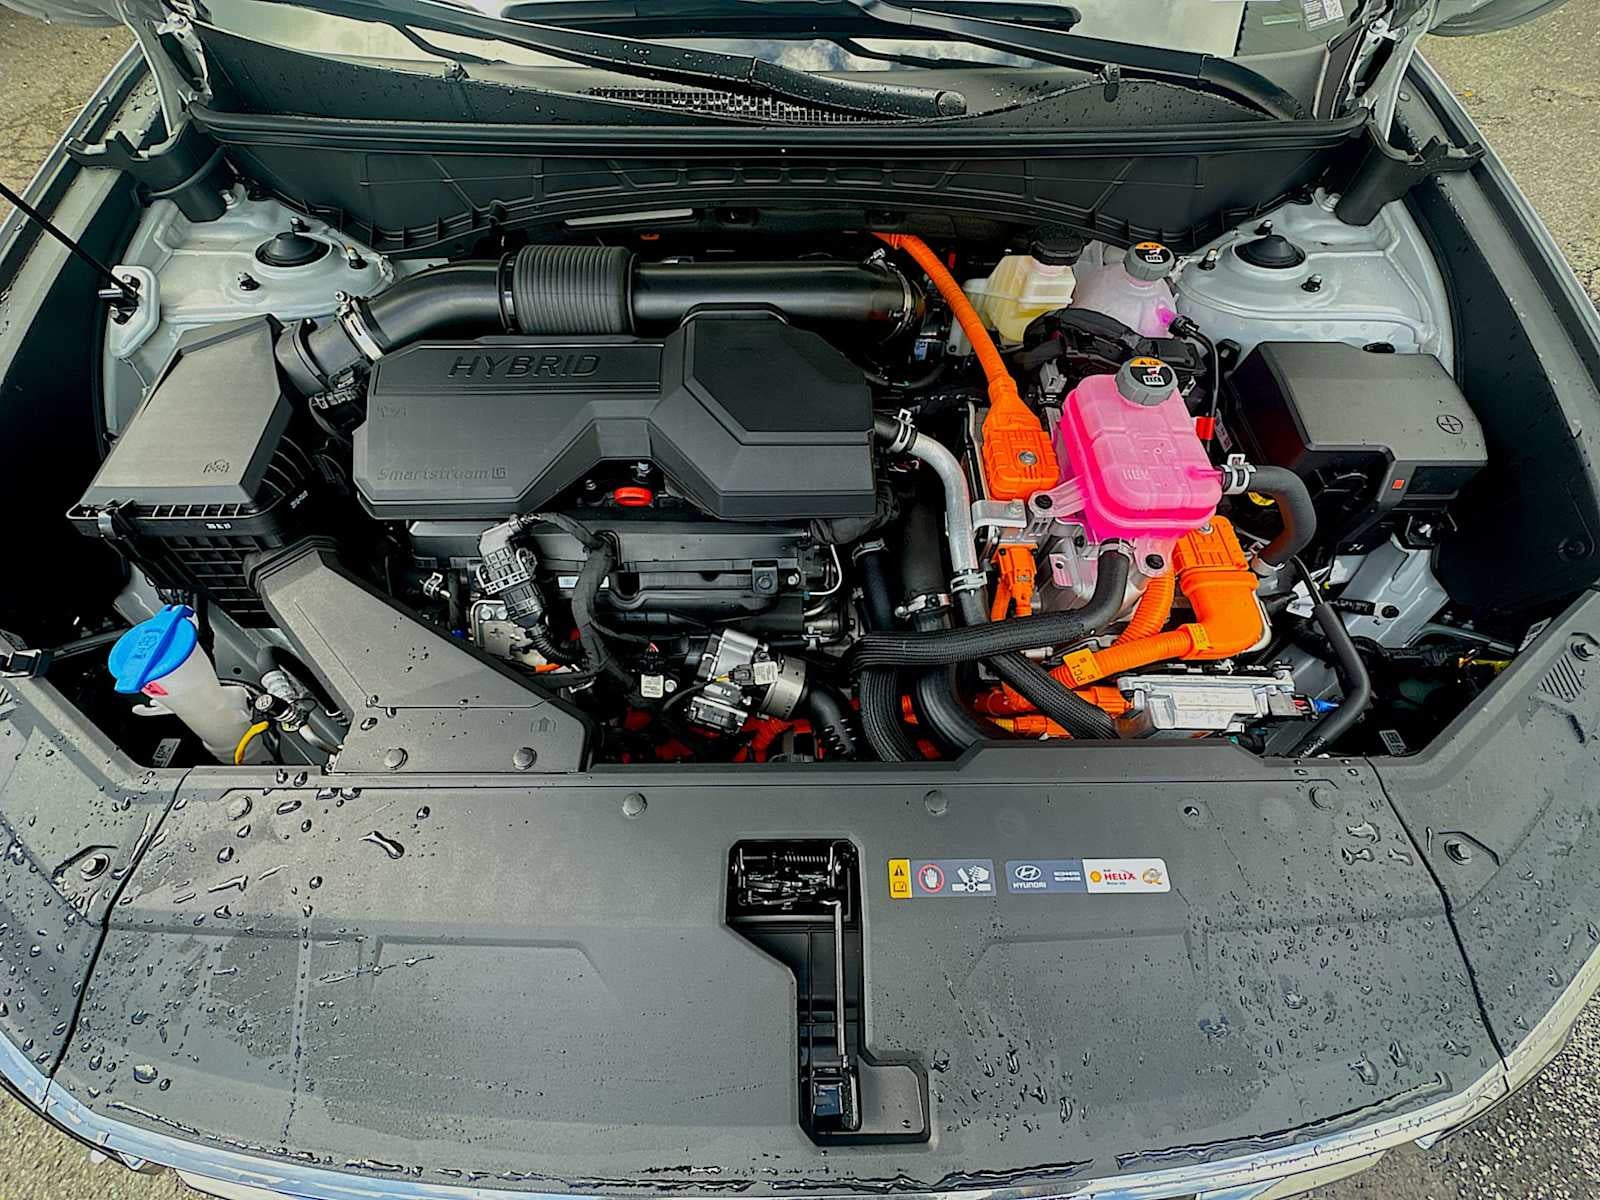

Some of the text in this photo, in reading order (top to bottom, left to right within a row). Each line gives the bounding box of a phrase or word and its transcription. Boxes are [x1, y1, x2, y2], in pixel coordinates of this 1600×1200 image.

[448, 355, 600, 378] HYBRID
[377, 466, 488, 480] Smartstream
[1104, 872, 1136, 880] HELIX
